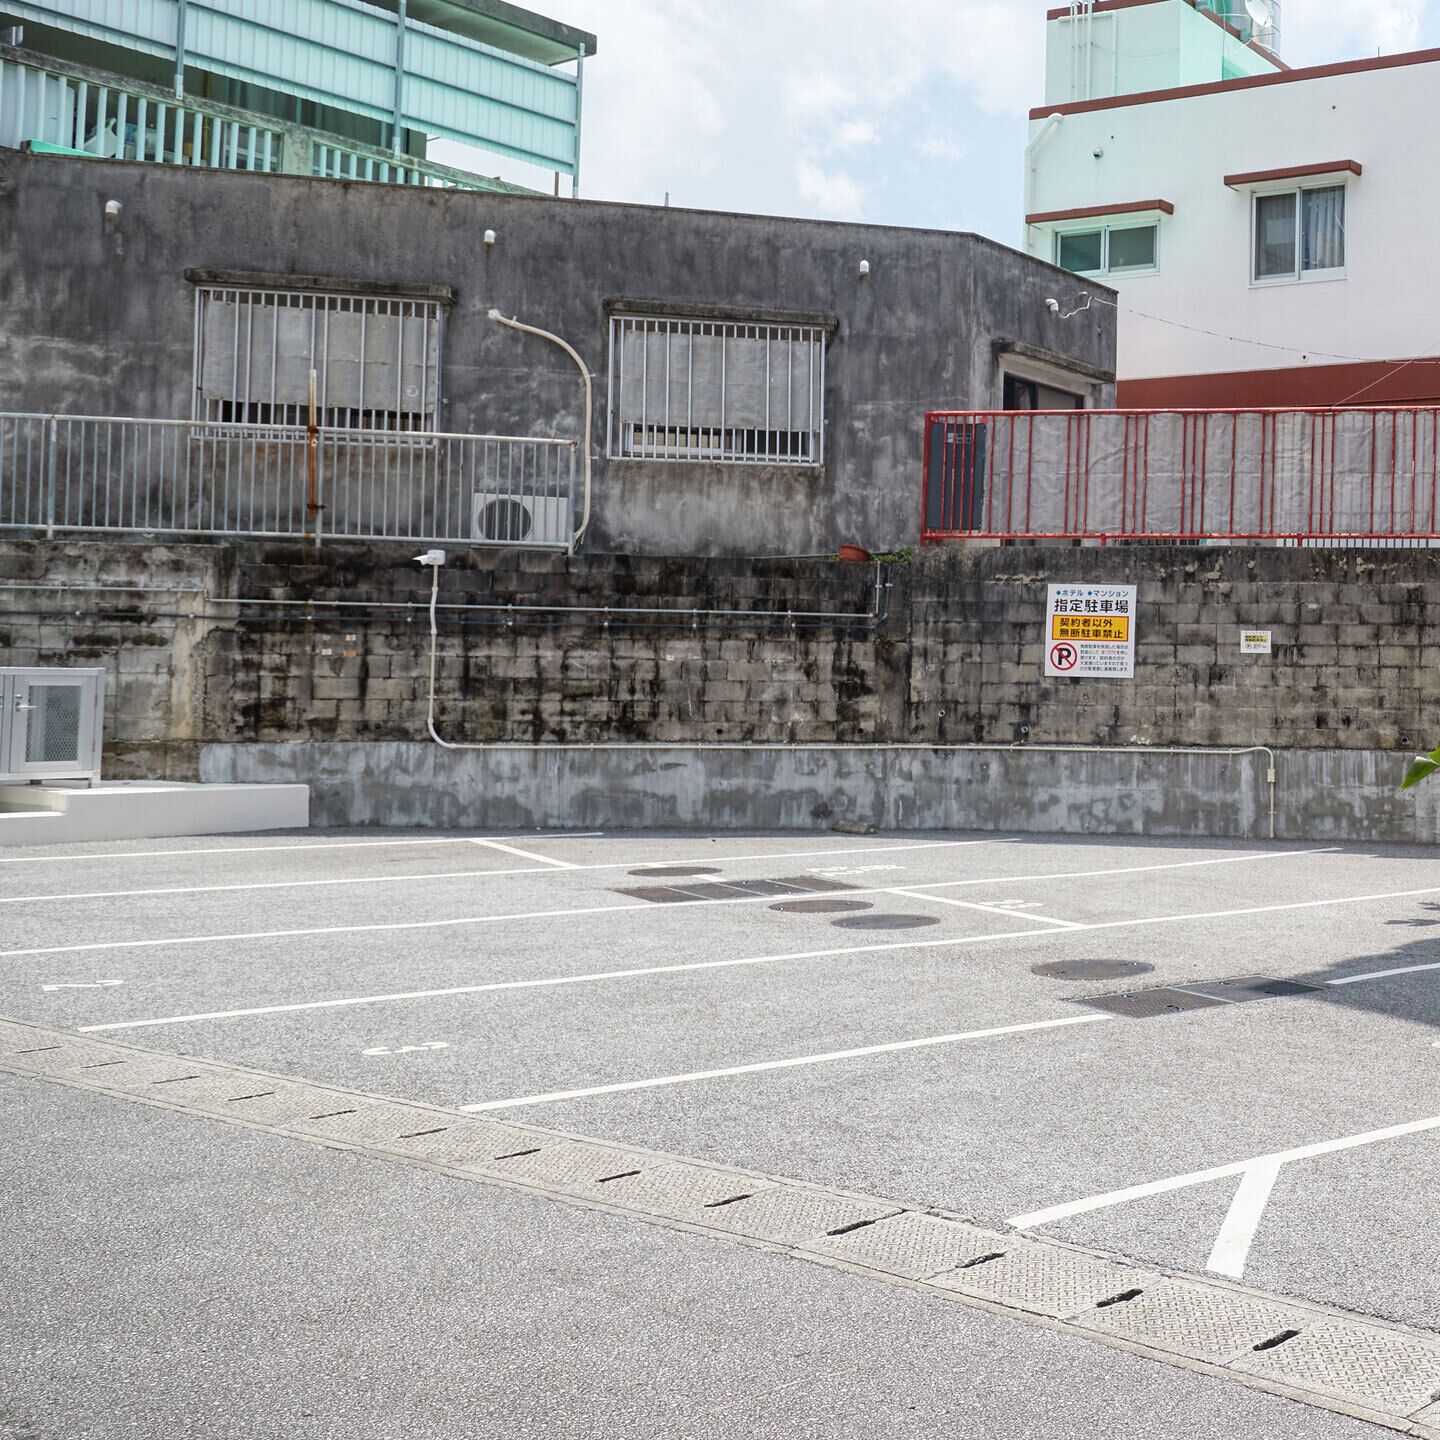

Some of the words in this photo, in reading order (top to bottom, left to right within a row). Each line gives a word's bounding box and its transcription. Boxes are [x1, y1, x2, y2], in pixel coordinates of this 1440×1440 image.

[1054, 599, 1129, 614] 指定駐車場
[1060, 617, 1113, 628] 契約者以外
[1059, 628, 1124, 639] 無断駐車禁止
[361, 1041, 450, 1056] 3
